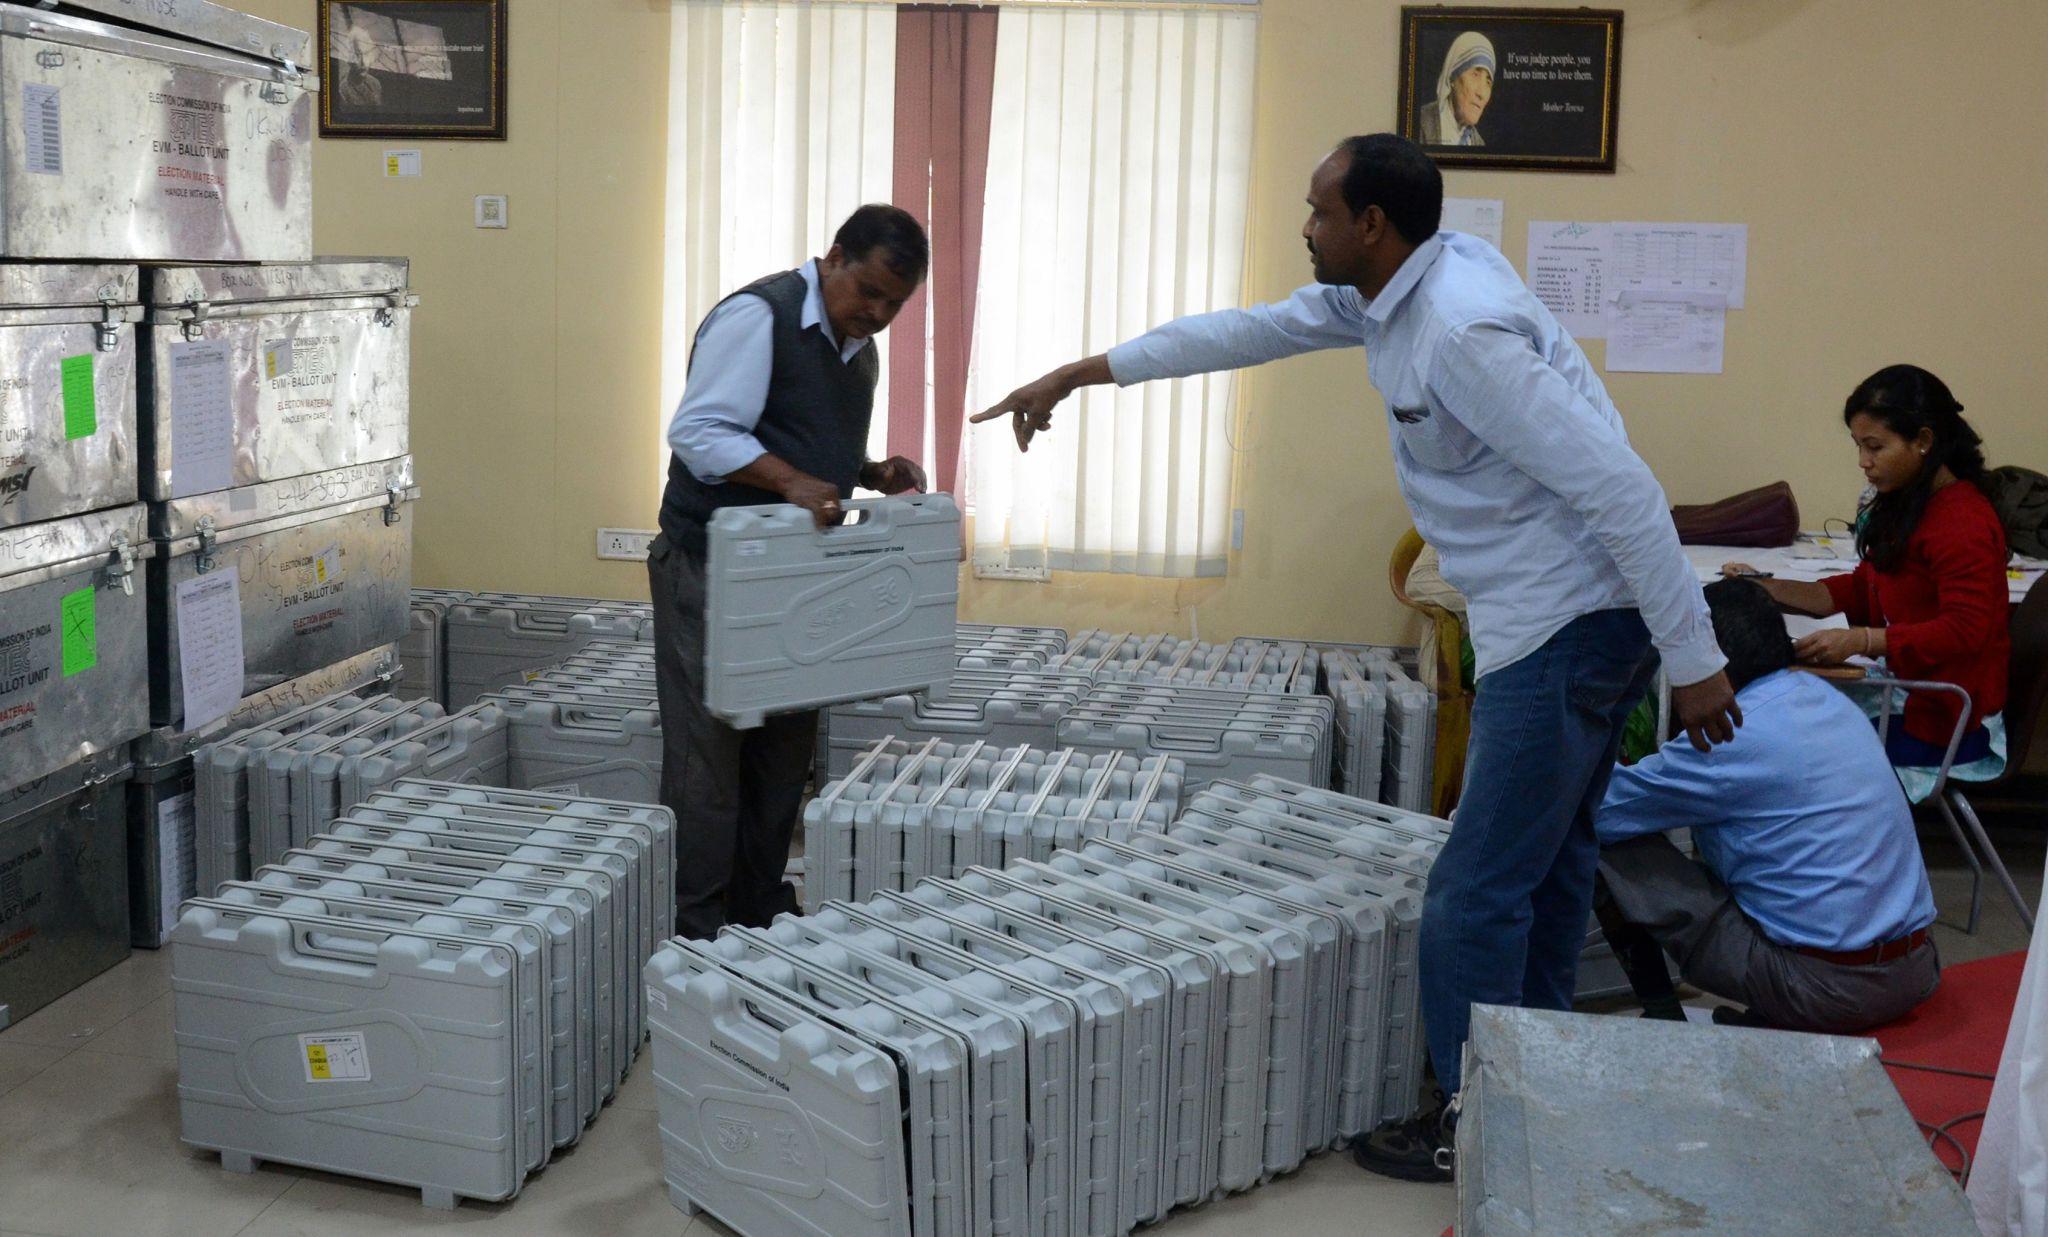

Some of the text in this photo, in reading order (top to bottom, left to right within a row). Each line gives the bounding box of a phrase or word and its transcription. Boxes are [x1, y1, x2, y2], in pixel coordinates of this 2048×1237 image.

[1507, 52, 1514, 64] If
[1515, 55, 1529, 66] you
[1529, 53, 1550, 67] judge
[1577, 56, 1591, 67] you
[1503, 68, 1520, 80] have
[1521, 71, 1531, 80] no
[1531, 69, 1547, 80] time
[1548, 71, 1557, 80] to
[1557, 69, 1573, 80] love
[148, 91, 177, 105] ELECTION
[176, 96, 210, 111] COMMISSION
[210, 102, 218, 111] OF
[1542, 102, 1584, 112] Mother Teresa
[153, 140, 171, 153] EVM
[178, 143, 210, 159] BALLOT
[212, 148, 230, 160] UNIT
[158, 166, 225, 187] ELECTION MATERIAL
[164, 187, 220, 200] HANDLE WITH CARE
[294, 336, 321, 347] COMMISSION
[322, 336, 328, 345] OF
[328, 335, 340, 345] INDIA
[272, 378, 287, 390] EVM
[292, 375, 320, 388] BALLOT
[321, 372, 337, 384] UNIT
[277, 398, 333, 411] ELECTION MATERIAL
[281, 411, 326, 424] HANDLE WITH CARE
[280, 558, 301, 571] ELECTION
[284, 594, 299, 607] EVM
[303, 585, 329, 602] BALLOT
[330, 581, 345, 594] UNIT
[293, 607, 345, 628] ELECTION MATERIAL
[25, 629, 34, 640] OF
[35, 624, 51, 636] INDIA
[28, 667, 49, 685] UNIT
[16, 718, 33, 732] CARE
[710, 1039, 732, 1058] Election
[732, 1053, 768, 1079] Commission
[775, 1078, 790, 1093] India
